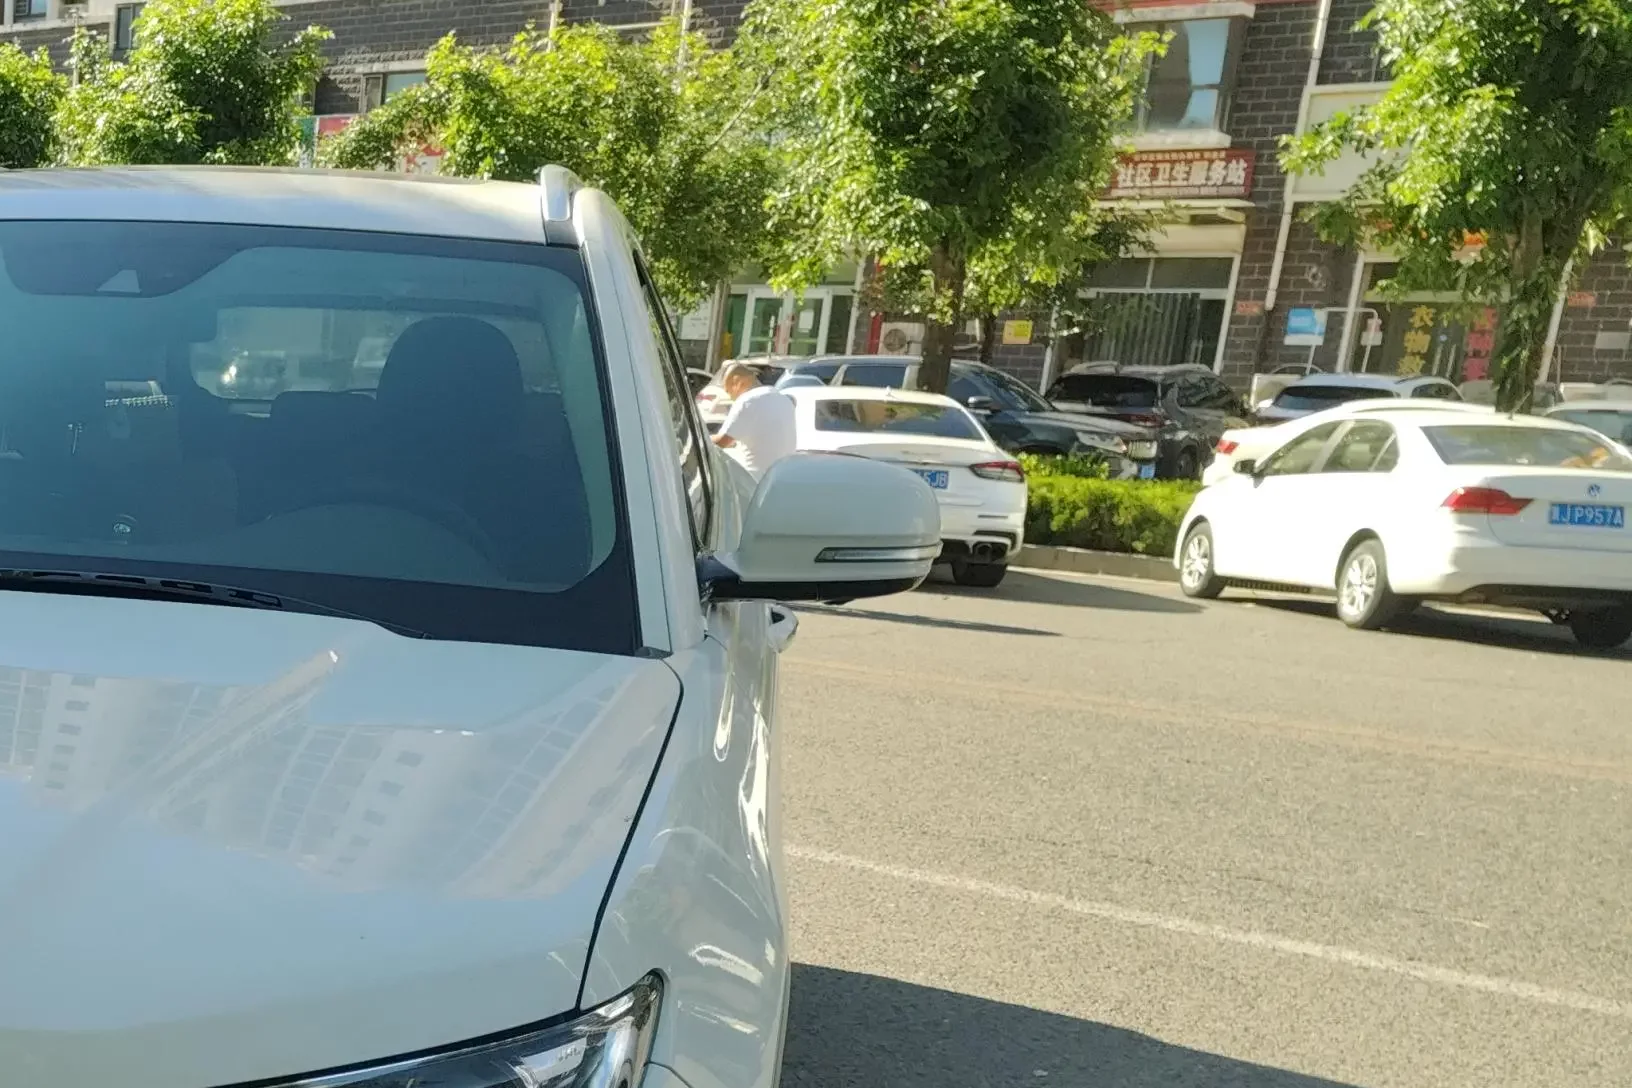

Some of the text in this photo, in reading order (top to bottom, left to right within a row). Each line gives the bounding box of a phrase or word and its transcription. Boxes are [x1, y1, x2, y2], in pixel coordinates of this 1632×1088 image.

[1116, 158, 1248, 187] 社区卫生服务站
